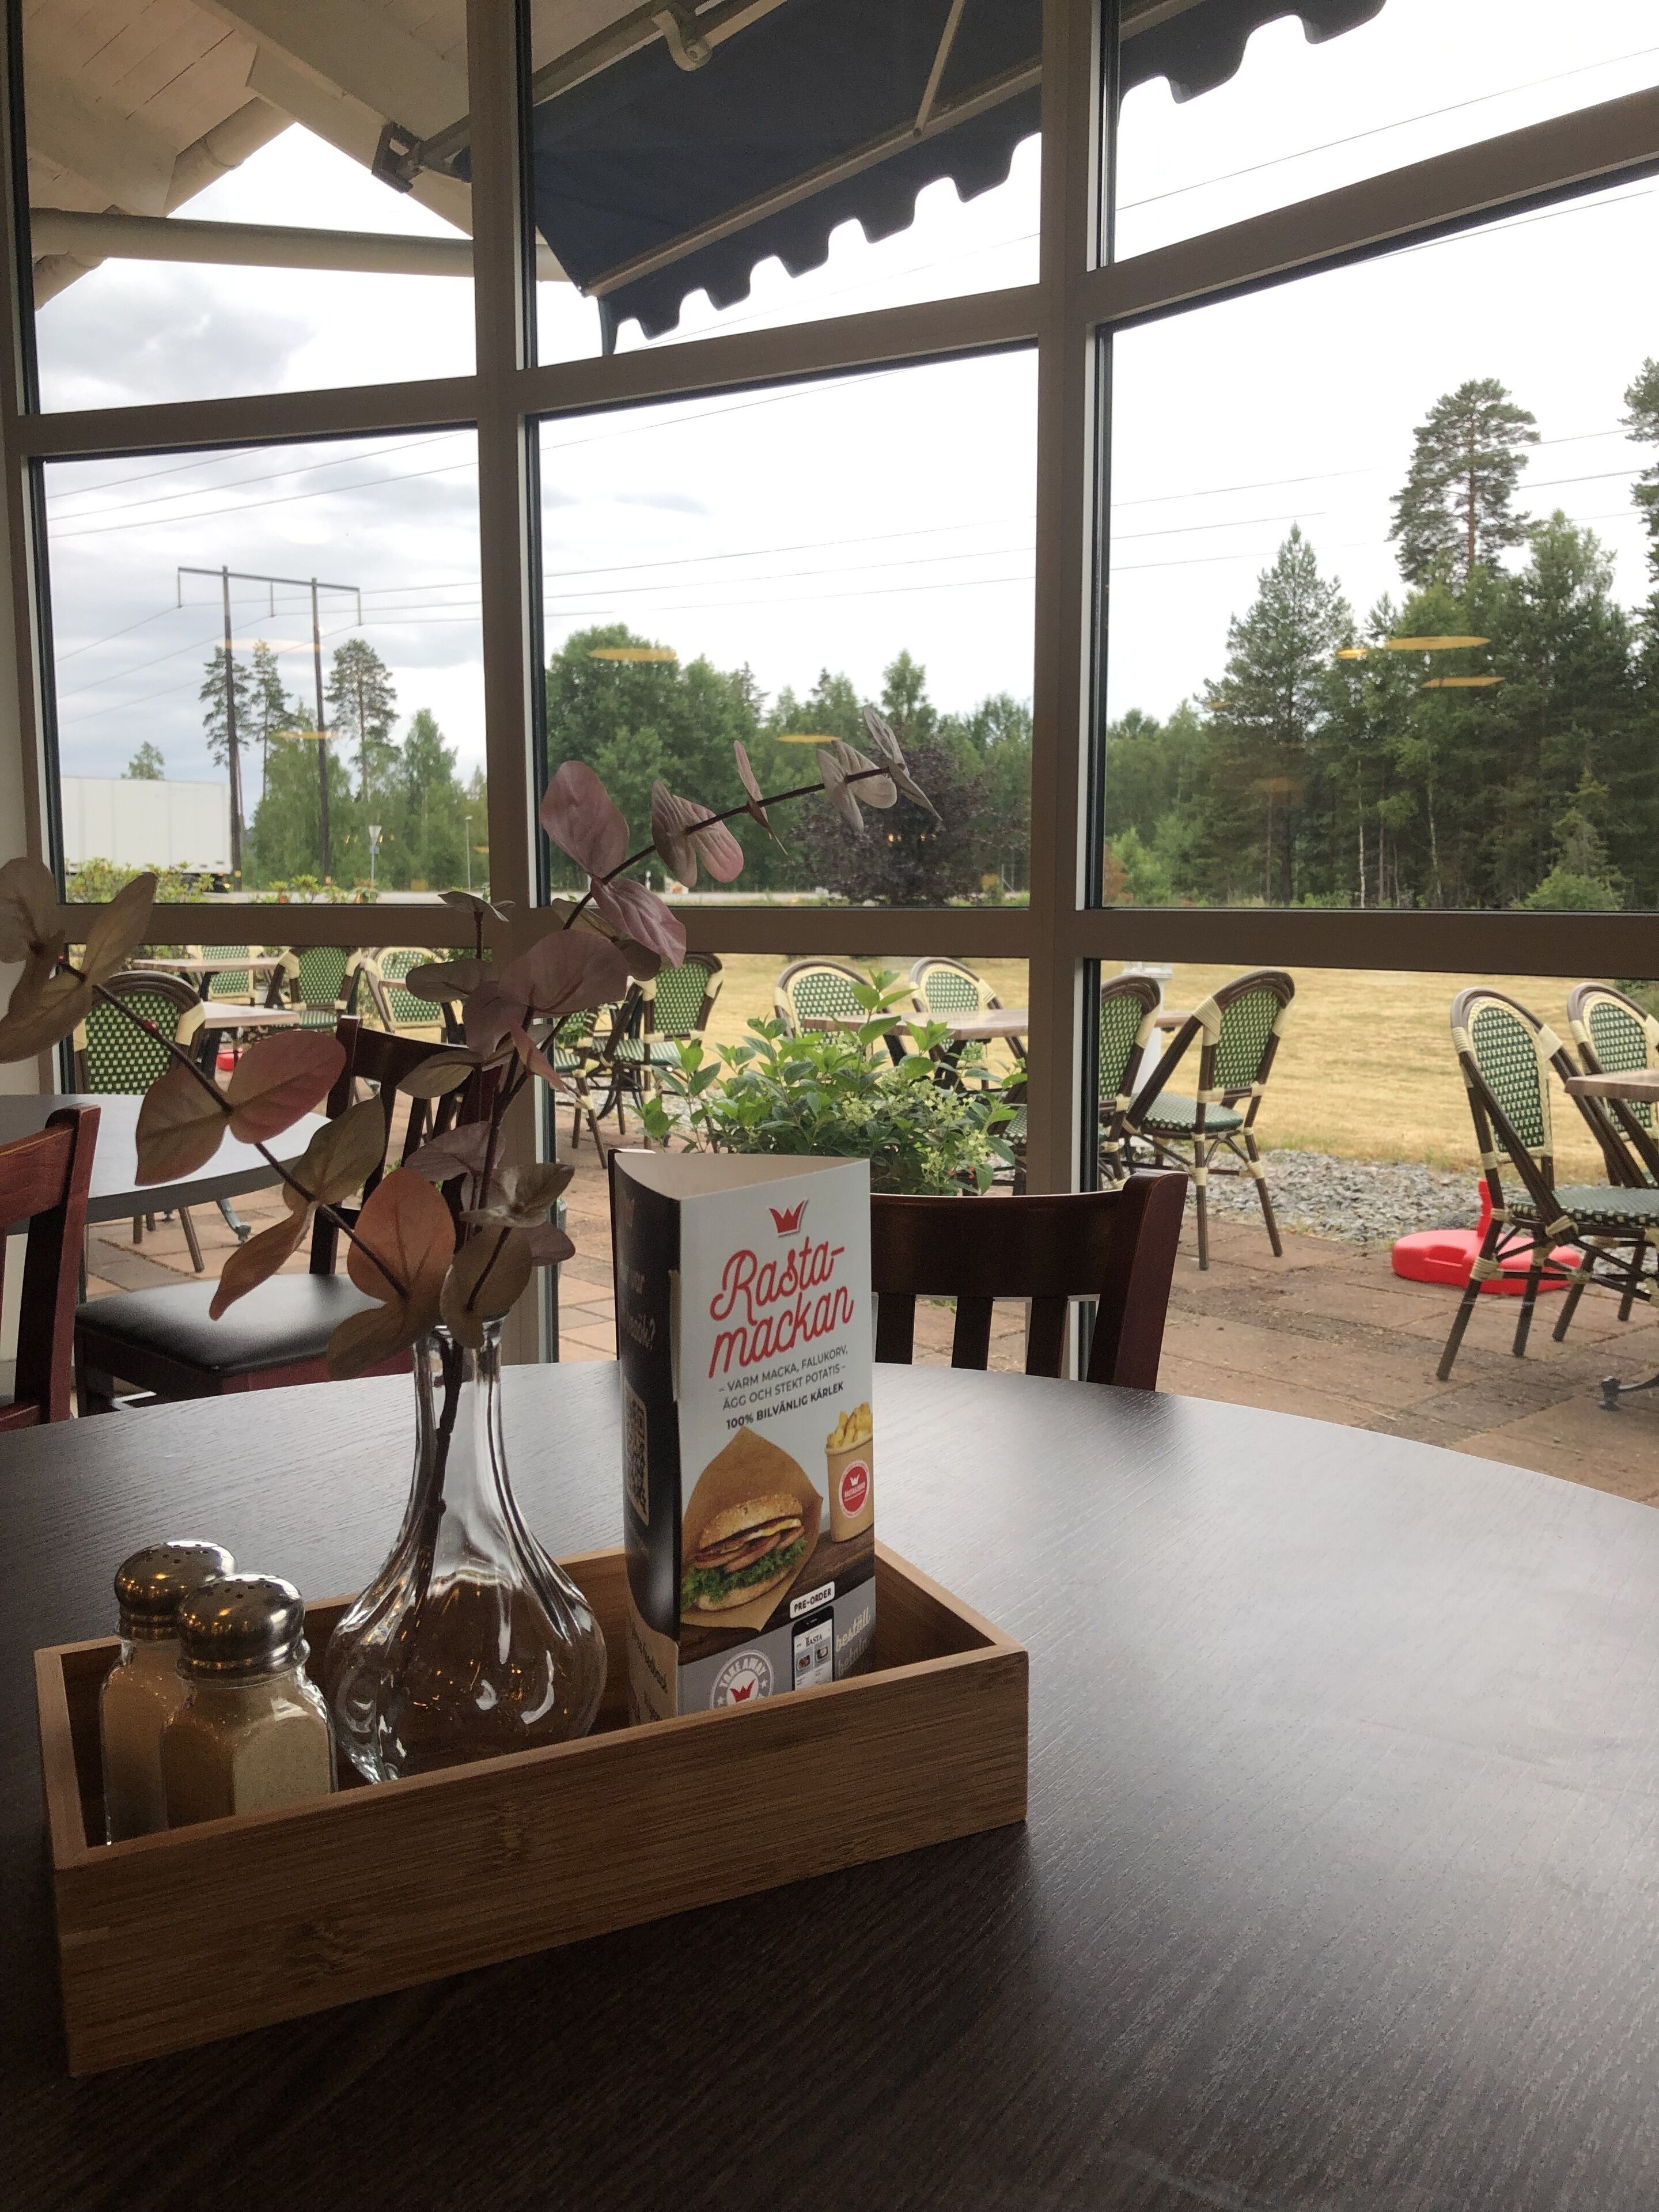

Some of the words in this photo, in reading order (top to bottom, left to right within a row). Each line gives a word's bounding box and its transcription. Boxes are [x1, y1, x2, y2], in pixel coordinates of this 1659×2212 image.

[710, 1236, 844, 1325] Rasta-
[709, 1286, 854, 1378] mackan
[723, 1394, 746, 1411] ÄGG
[749, 1387, 772, 1403] OCH
[775, 1376, 803, 1396] STEKT
[805, 1363, 840, 1385] POTATIS
[727, 1374, 759, 1392] VARM
[762, 1362, 799, 1382] MACKA,
[801, 1345, 848, 1370] FALUKORV,
[726, 1414, 753, 1430] 100%
[756, 1395, 808, 1421] BILVÄNLIG
[810, 1381, 844, 1402] KÄRLEK
[794, 1588, 831, 1613] PRE-ORDER
[719, 1661, 742, 1688] TAKE
[742, 1657, 767, 1677] AWAY
